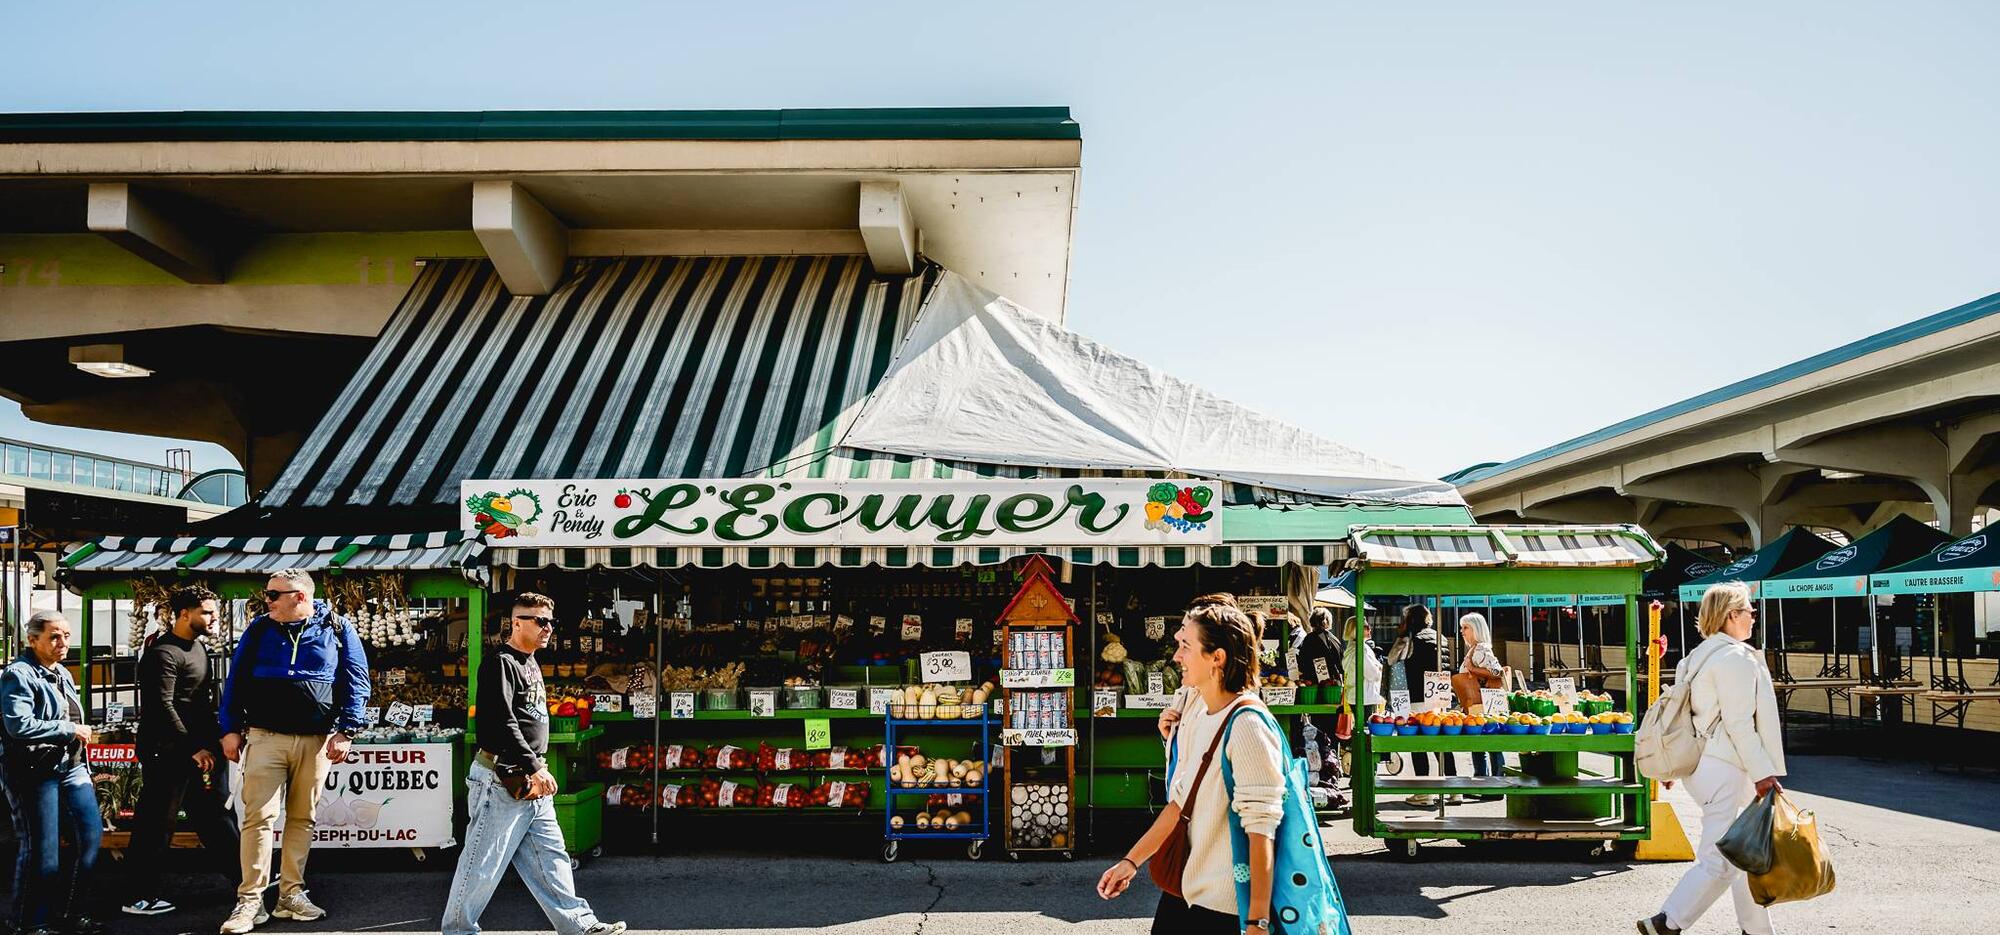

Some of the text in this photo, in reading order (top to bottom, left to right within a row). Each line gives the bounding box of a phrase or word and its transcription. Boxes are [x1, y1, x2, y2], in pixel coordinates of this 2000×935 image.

[557, 483, 598, 508] Eric
[574, 509, 585, 519] &
[550, 510, 605, 540] Pendy
[1788, 583, 1834, 592] LA CHOPE ANGUS
[1904, 576, 1964, 587] L'AUTRE BRASSERIE
[1425, 681, 1450, 698] 3.00
[90, 748, 125, 759] FLEUR
[337, 751, 426, 765] CTEUR
[324, 767, 439, 795] U QUÉBEC
